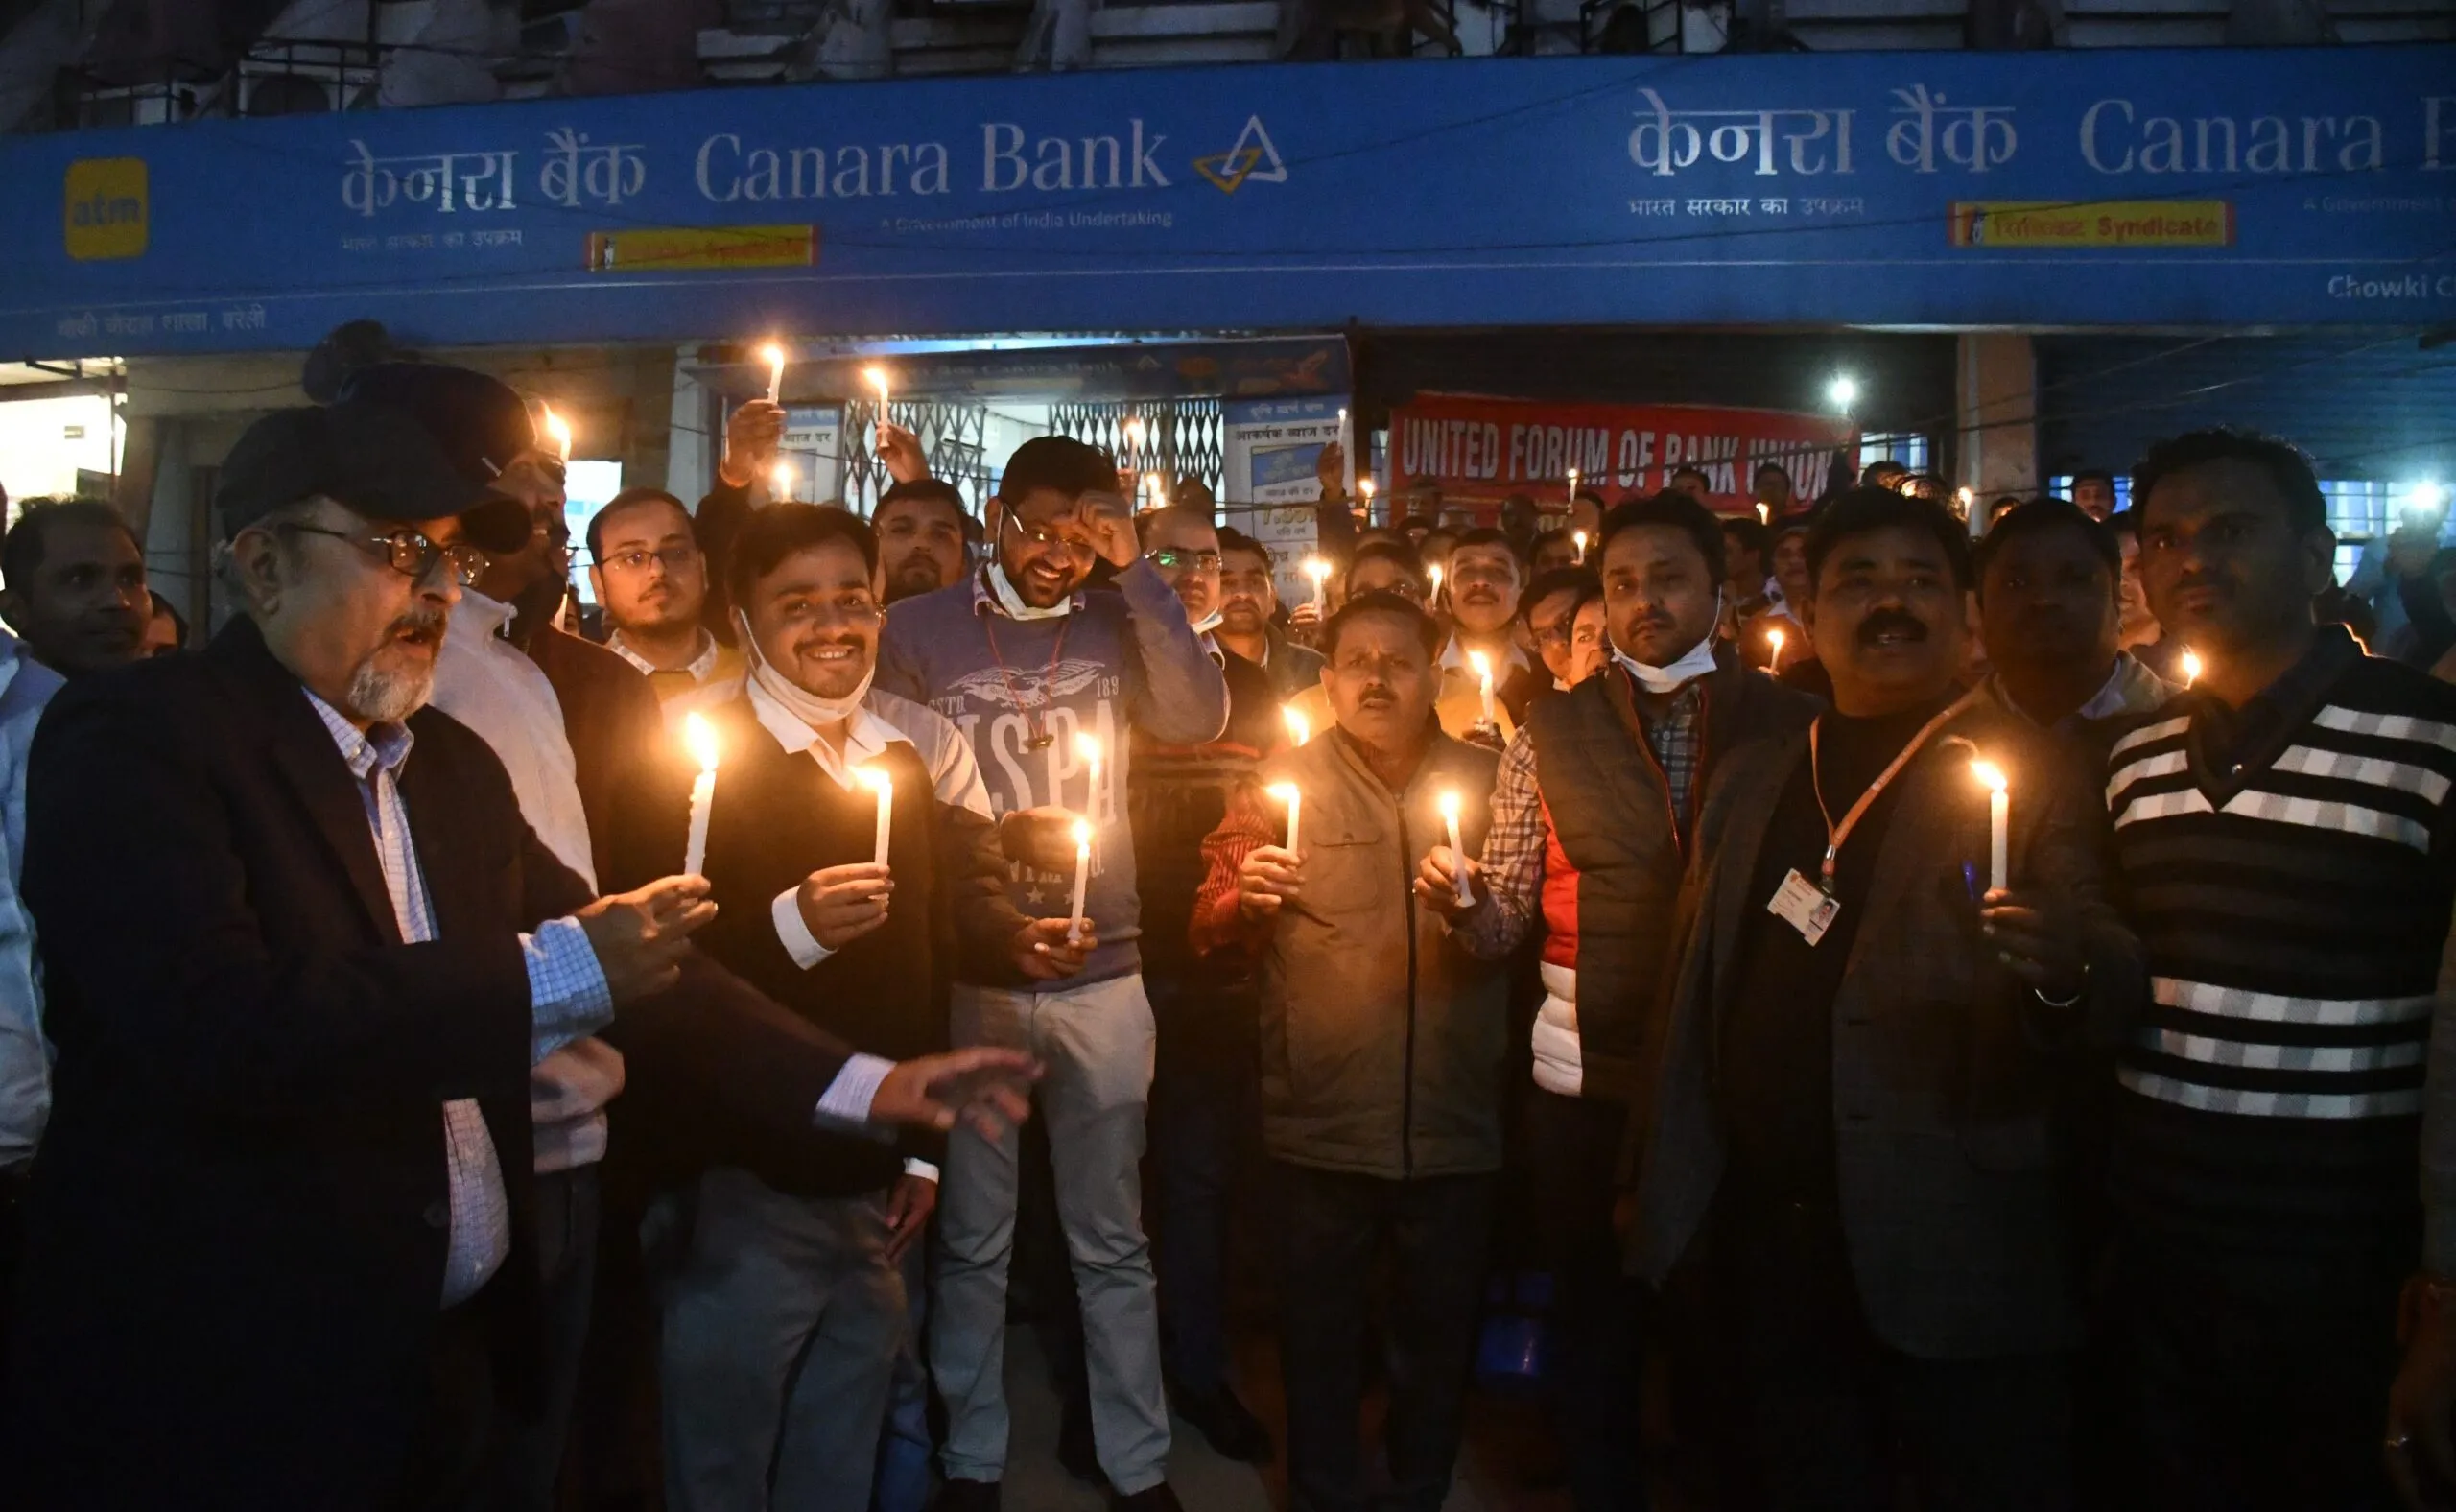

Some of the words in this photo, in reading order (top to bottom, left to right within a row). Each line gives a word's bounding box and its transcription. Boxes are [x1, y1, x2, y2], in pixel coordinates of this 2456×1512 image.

[1628, 87, 1856, 177] केनरा
[1886, 83, 2016, 174] बैंक
[2078, 98, 2386, 175] Canara
[342, 139, 520, 217] केनरा
[540, 127, 646, 207] बैंक
[695, 132, 951, 202] Canara
[977, 118, 1172, 192] Bank
[73, 191, 141, 226] atm
[1002, 211, 1019, 228] of
[1024, 211, 1064, 229] India
[1069, 208, 1173, 229] Undertaking
[1628, 197, 1676, 217] भारत
[1686, 197, 1751, 217] सरकार
[1761, 196, 1789, 216] का
[1800, 196, 1865, 217] उपक्रम
[2097, 215, 2219, 243] Syndicate
[2327, 273, 2428, 298] Chowki
[1236, 424, 1283, 441] आकर्षक
[1402, 416, 1499, 482] UNITED
[1508, 423, 1610, 489] FORUM
[1618, 429, 1655, 488] OF
